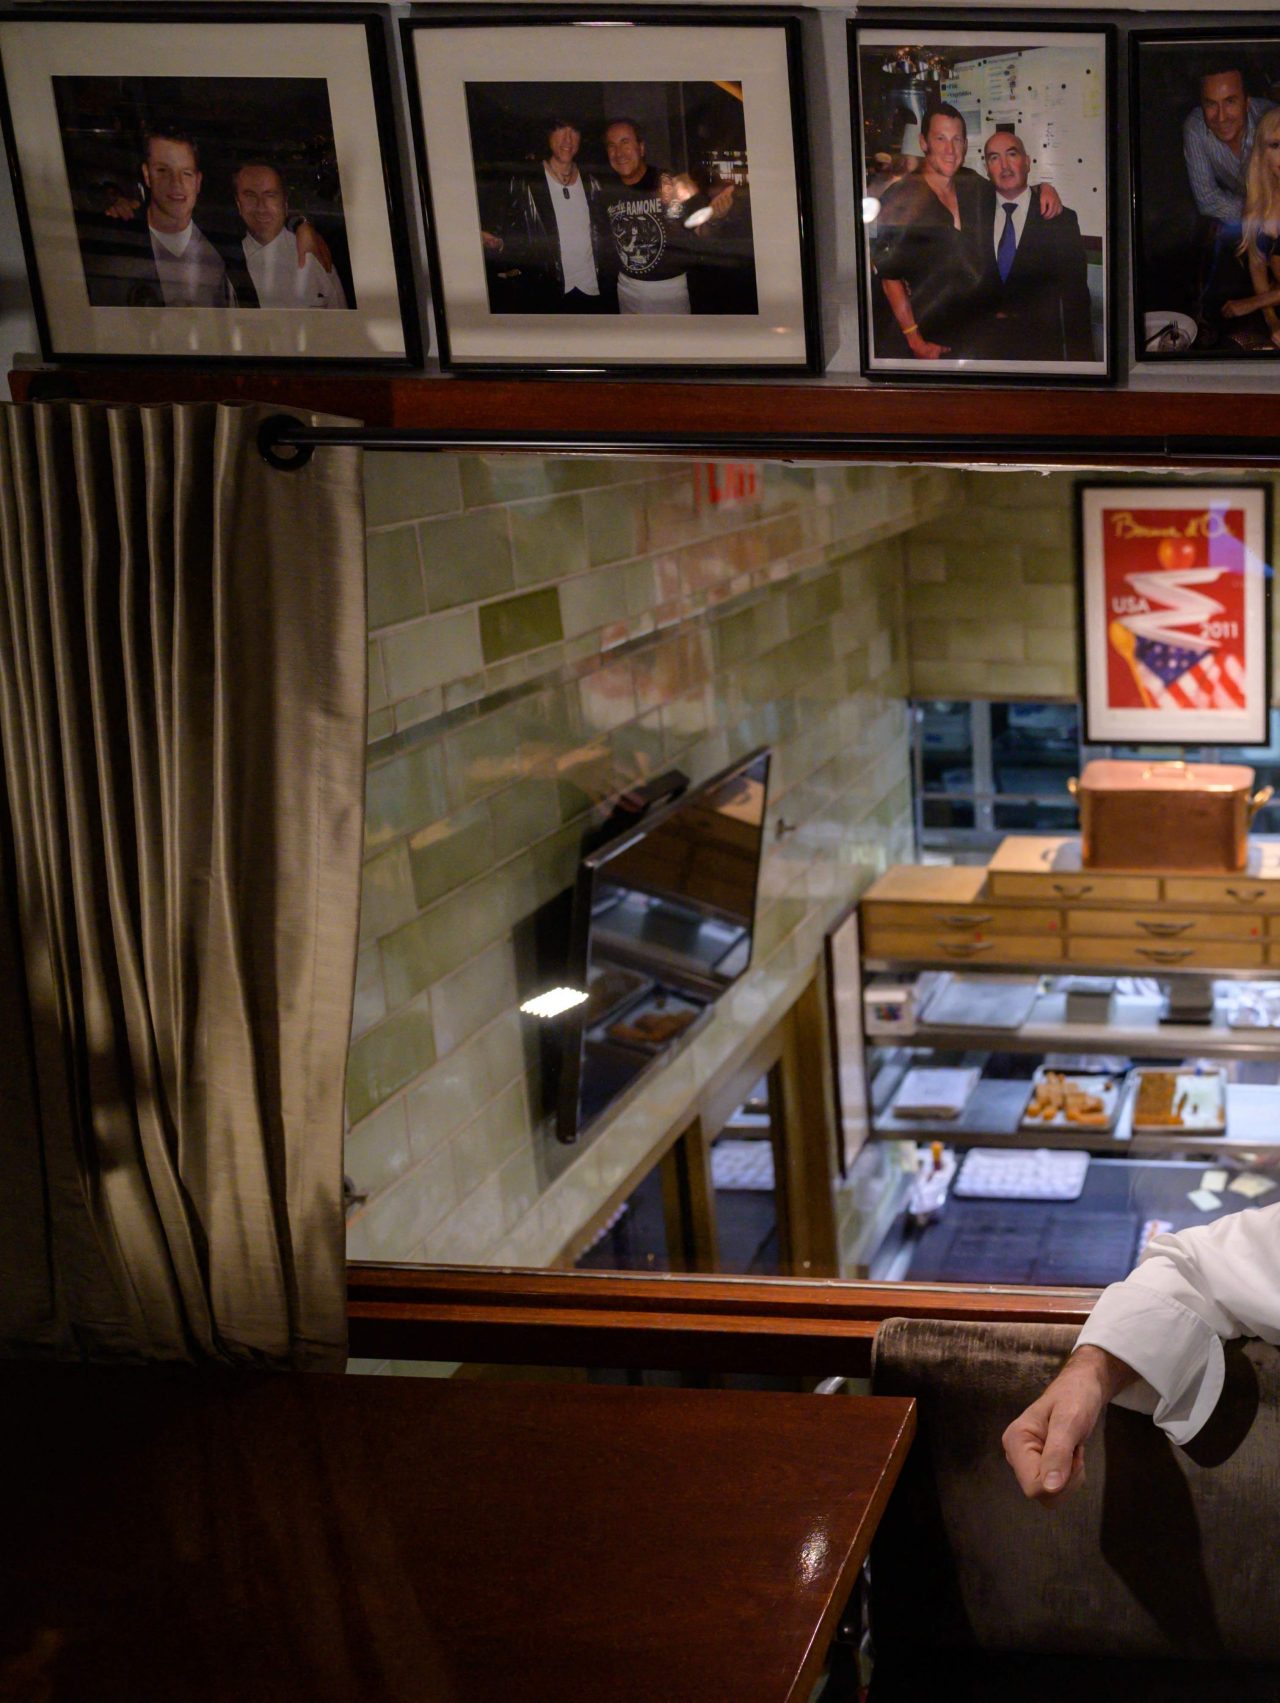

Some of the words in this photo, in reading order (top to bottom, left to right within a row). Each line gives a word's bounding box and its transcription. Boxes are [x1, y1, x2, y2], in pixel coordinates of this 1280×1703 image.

[626, 198, 661, 215] RAMONE
[1112, 596, 1151, 614] USA
[1200, 621, 1239, 639] 2011
